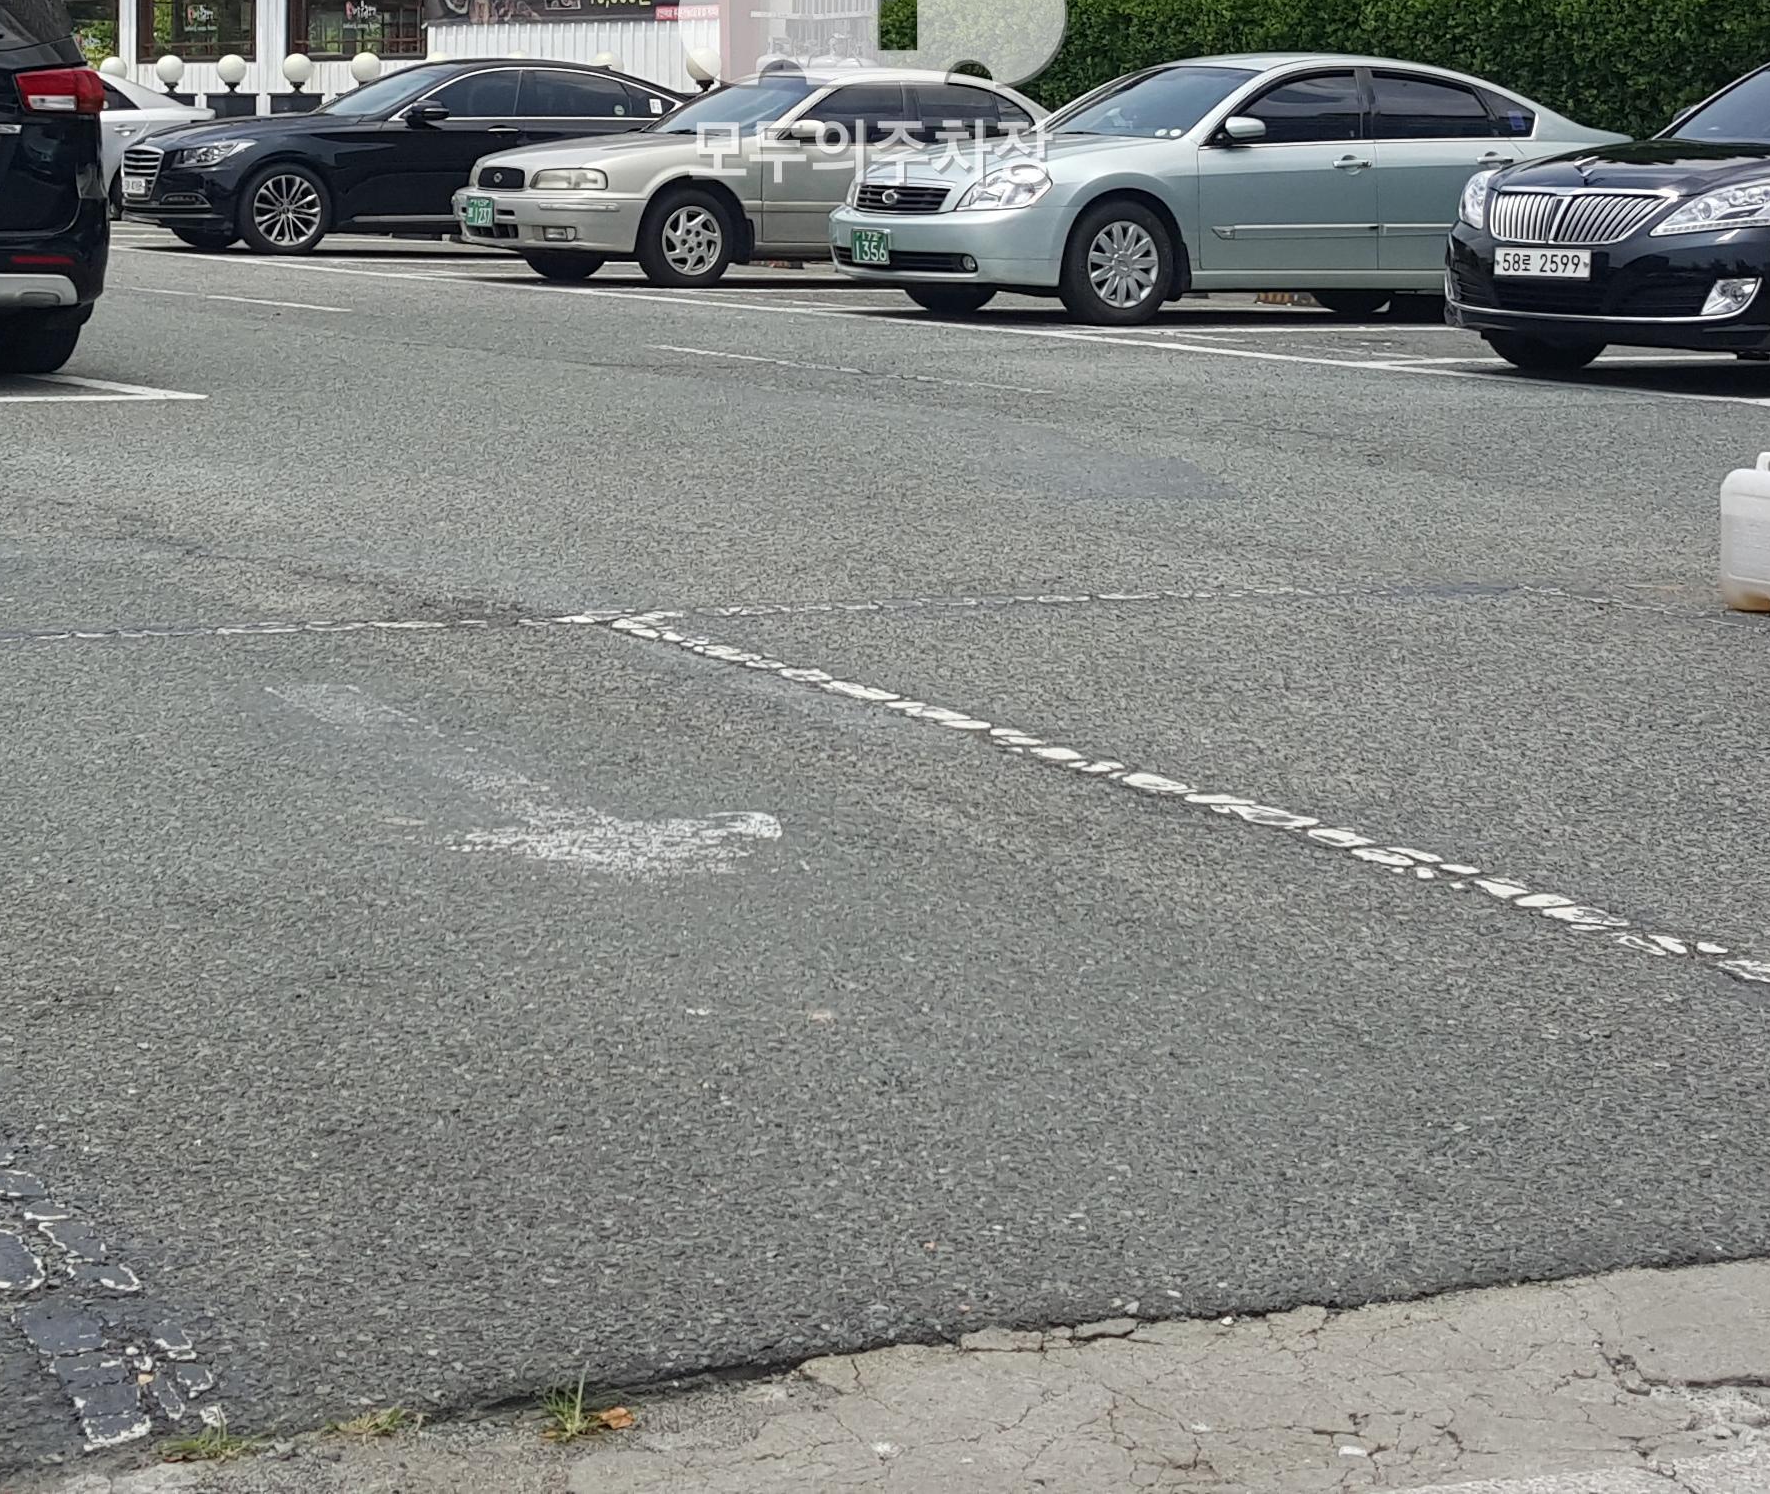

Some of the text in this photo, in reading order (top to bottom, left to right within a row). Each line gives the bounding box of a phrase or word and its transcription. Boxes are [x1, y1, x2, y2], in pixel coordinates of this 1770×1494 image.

[856, 241, 887, 261] 1356
[1502, 253, 1581, 273] 58로 2599
